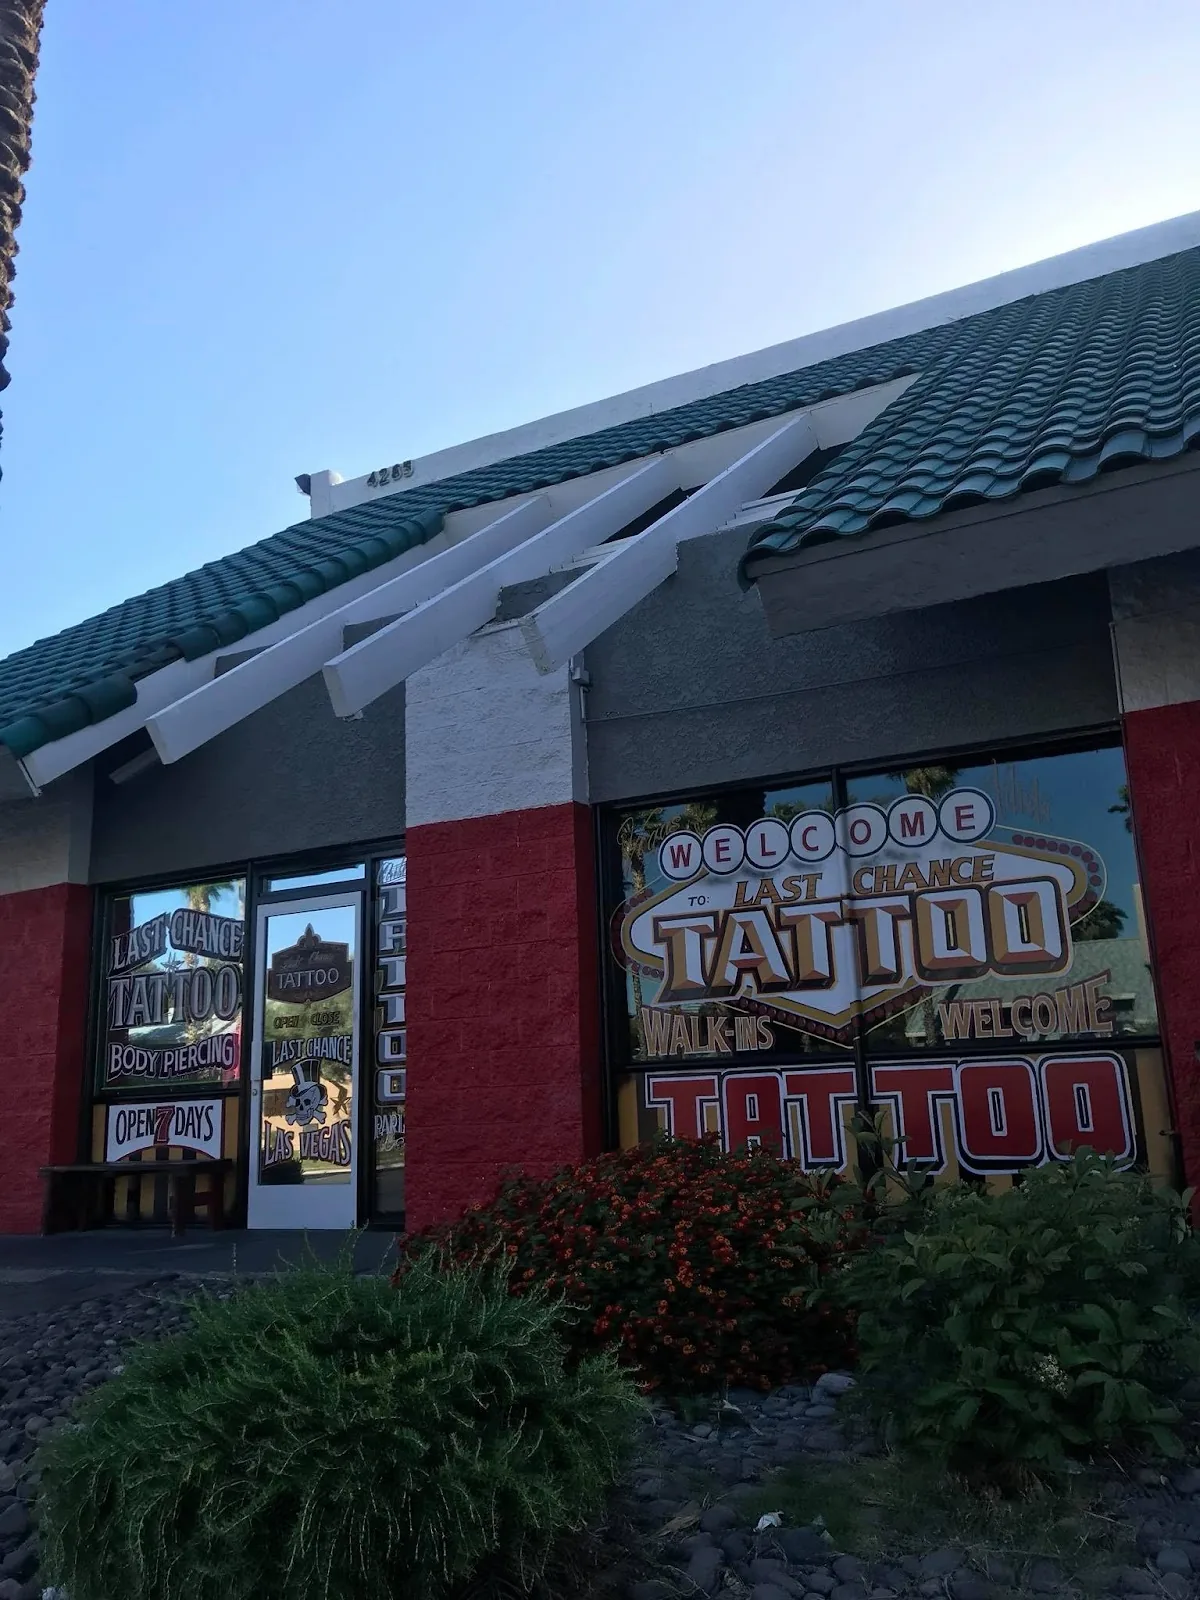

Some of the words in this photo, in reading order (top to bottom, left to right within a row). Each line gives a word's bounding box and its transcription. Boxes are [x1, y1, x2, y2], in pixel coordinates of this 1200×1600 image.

[668, 803, 978, 869] WELCOME
[733, 872, 824, 907] LAST
[852, 854, 996, 895] CHANCE
[113, 916, 169, 970] LAST
[170, 911, 243, 957] CHANCE
[654, 878, 1071, 1001] TATTOO
[111, 965, 241, 1027] TATTOO
[276, 967, 340, 990] TATTOO
[273, 1014, 299, 1029] OPEN
[310, 1009, 341, 1027] CLOSE
[641, 1006, 775, 1058] WALK-INS
[938, 968, 1115, 1041] WELCOME
[110, 1042, 159, 1074] BODY
[162, 1035, 236, 1073] PIERCING
[271, 1038, 304, 1067] LAST
[305, 1033, 351, 1067] CHANCE
[115, 1107, 156, 1146] OPEN
[154, 1104, 176, 1144] 7
[174, 1104, 215, 1142] DAYS
[645, 1053, 1137, 1176] TATTOO
[263, 1119, 294, 1170] LAS
[297, 1117, 351, 1168] VEGAS
